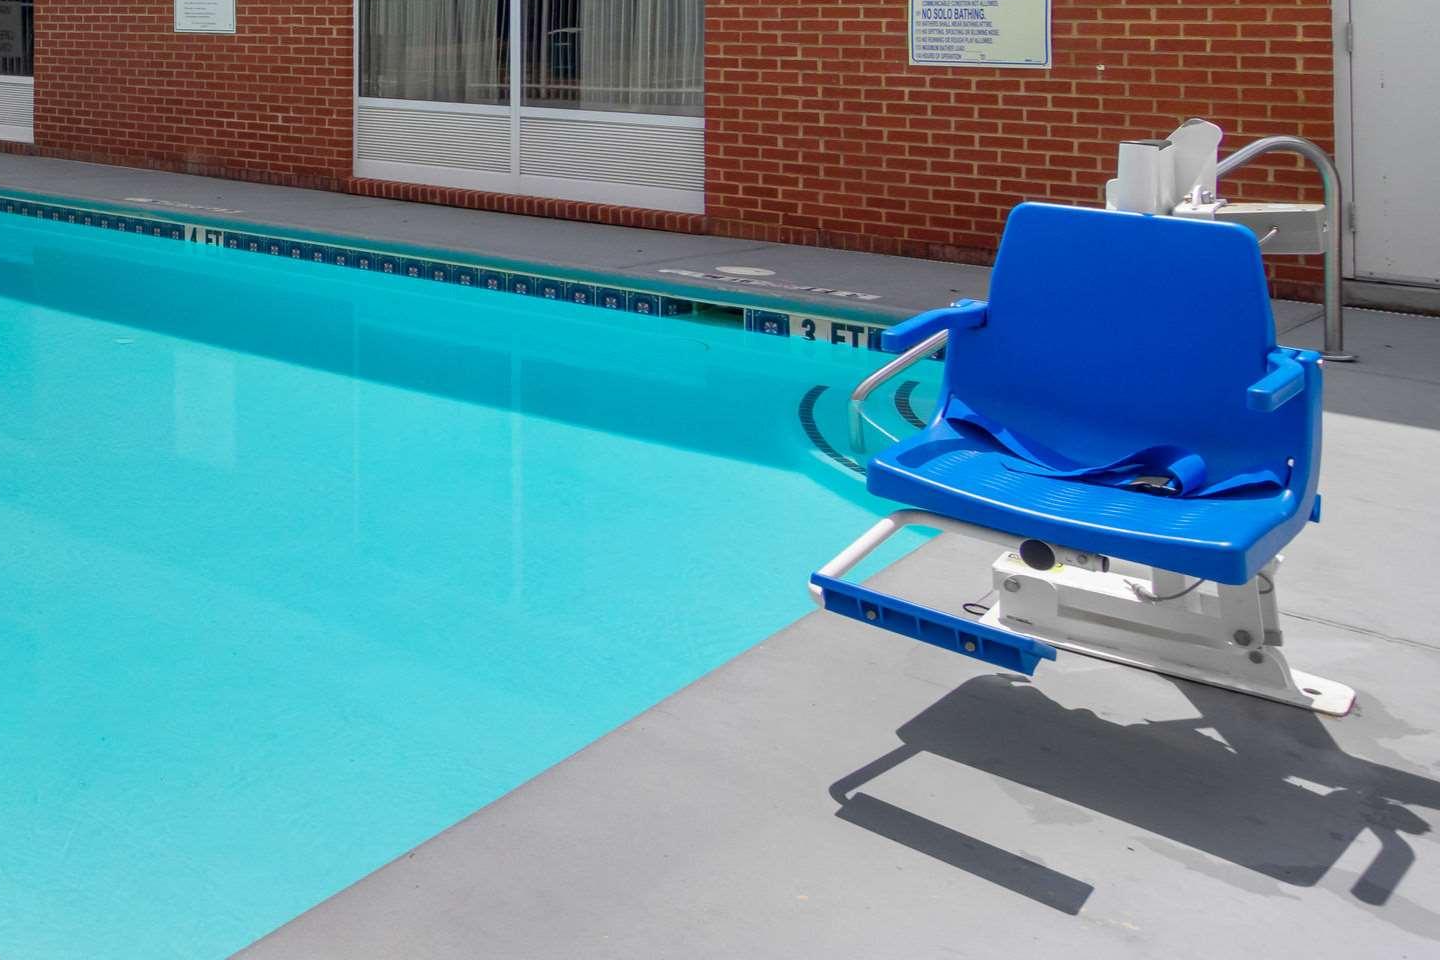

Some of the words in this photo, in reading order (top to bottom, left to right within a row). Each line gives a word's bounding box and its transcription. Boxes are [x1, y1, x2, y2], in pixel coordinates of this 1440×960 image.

[921, 8, 931, 20] NO
[933, 8, 953, 20] SOLO
[205, 229, 222, 247] FT
[801, 318, 816, 341] 3
[831, 322, 864, 348] FT
